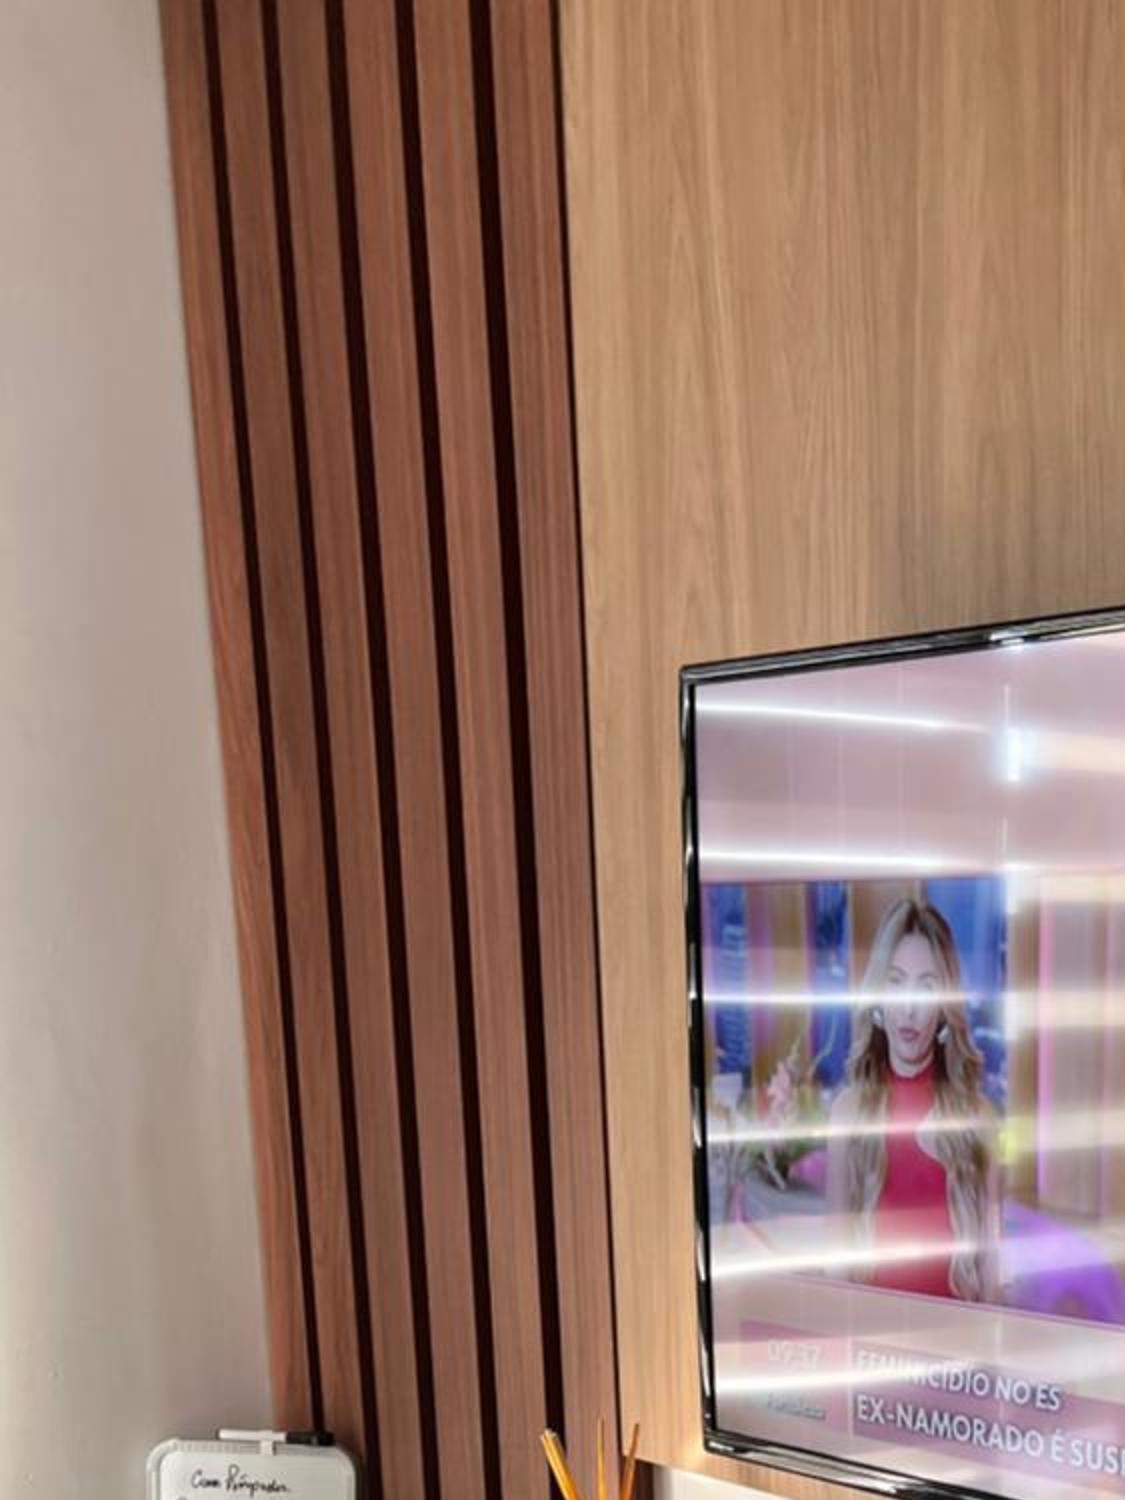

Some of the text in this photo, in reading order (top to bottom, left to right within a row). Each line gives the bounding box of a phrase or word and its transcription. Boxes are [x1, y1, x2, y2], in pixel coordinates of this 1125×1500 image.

[994, 1376, 1030, 1404] NO
[1036, 1385, 1061, 1411] ES
[856, 1394, 1044, 1456] EX-NAMORADO
[1050, 1429, 1064, 1463] É
